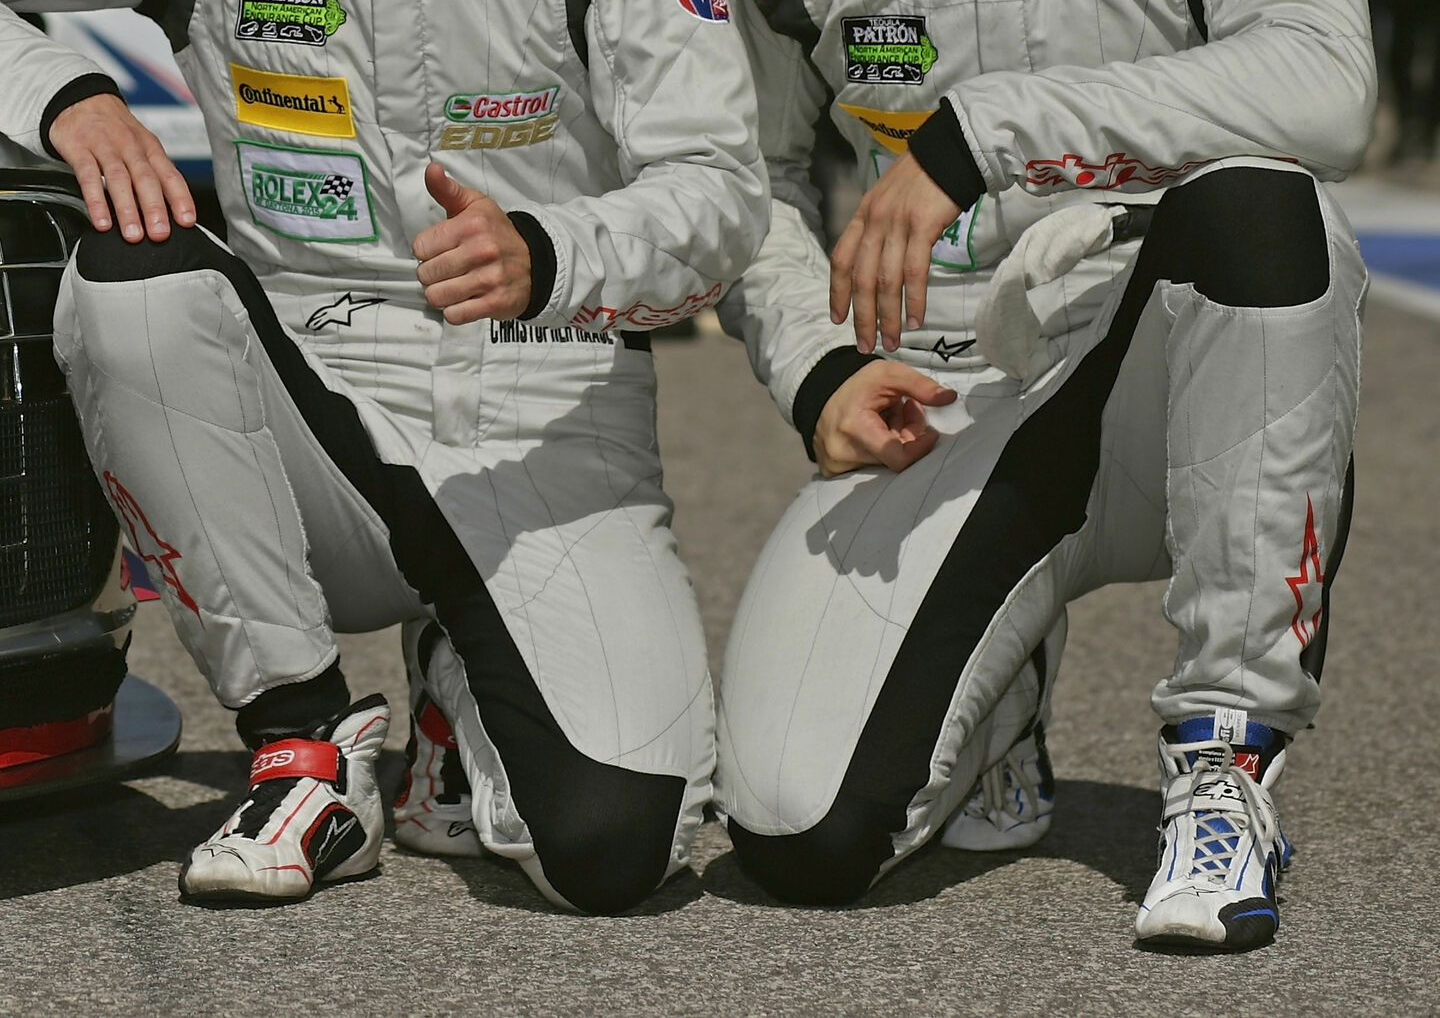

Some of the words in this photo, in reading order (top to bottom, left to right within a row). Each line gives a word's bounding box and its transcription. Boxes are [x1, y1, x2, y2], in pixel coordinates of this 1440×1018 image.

[245, 9, 300, 23] ENDURANCE
[303, 13, 323, 25] CUP
[852, 23, 919, 44] PATRÓN
[239, 83, 328, 114] Continental
[473, 92, 550, 119] Castrol
[439, 114, 559, 150] EDGE
[252, 171, 324, 209] ROLEX
